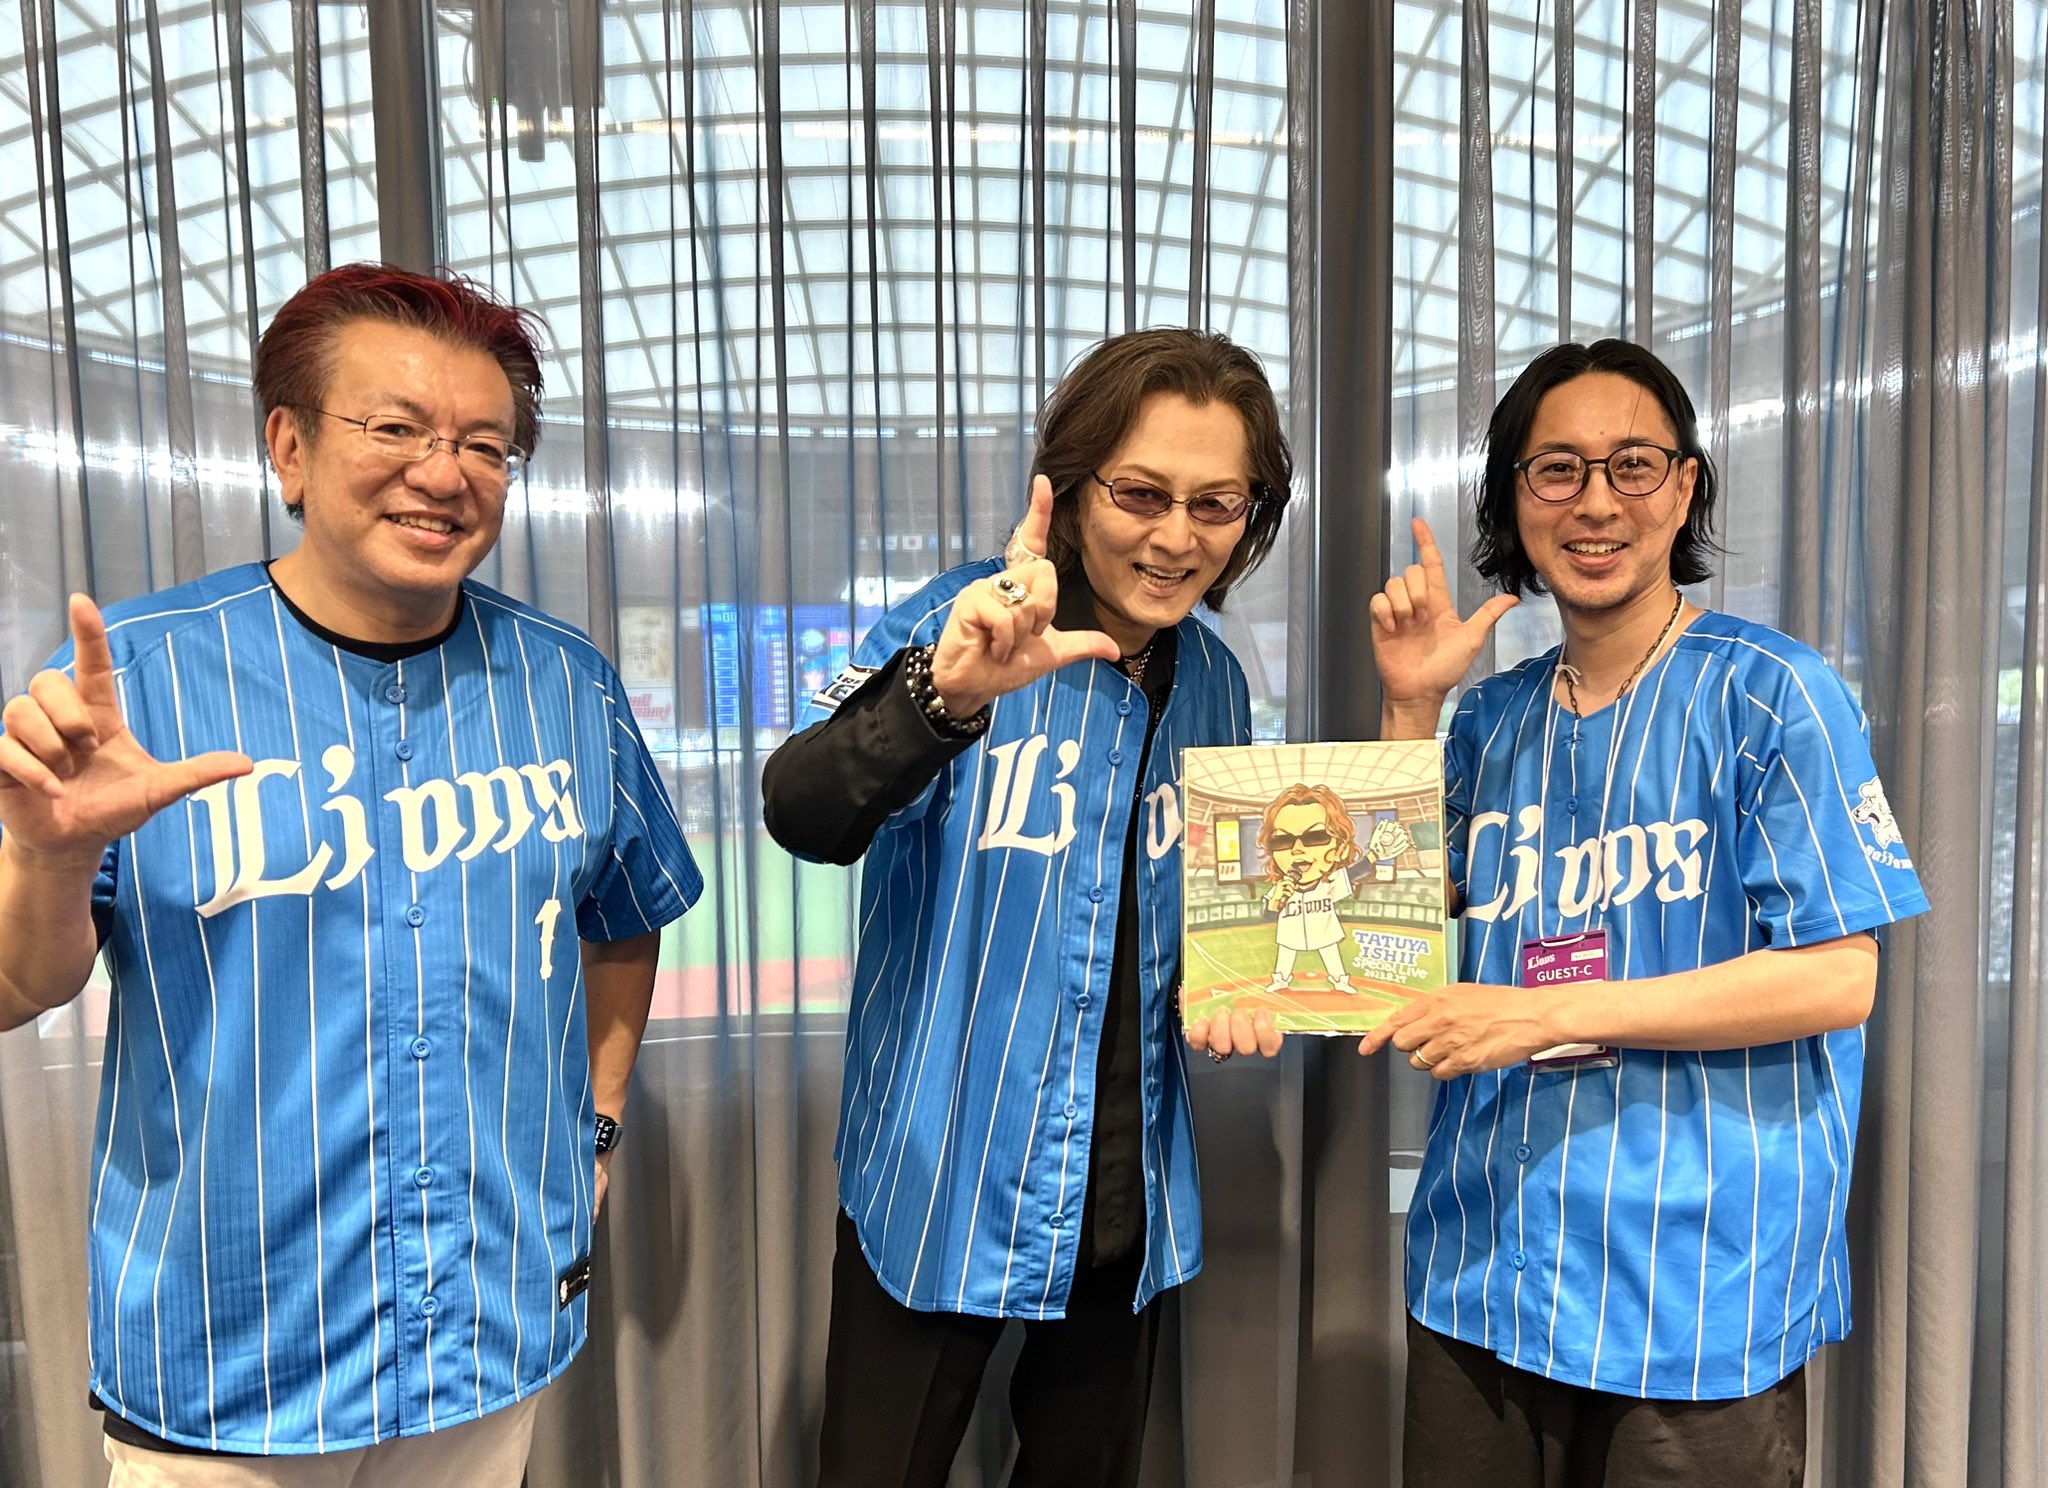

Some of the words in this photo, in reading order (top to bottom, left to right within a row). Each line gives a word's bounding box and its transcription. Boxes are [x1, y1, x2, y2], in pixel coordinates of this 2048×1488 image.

[977, 733, 1184, 860] Lio
[195, 744, 584, 919] Lions
[1282, 897, 1332, 919] Lions
[534, 899, 562, 980] 1
[1355, 932, 1430, 954] TATUYA
[1361, 946, 1416, 965] ISHII
[1527, 953, 1556, 971] Lions
[1536, 964, 1593, 983] GUEST-C
